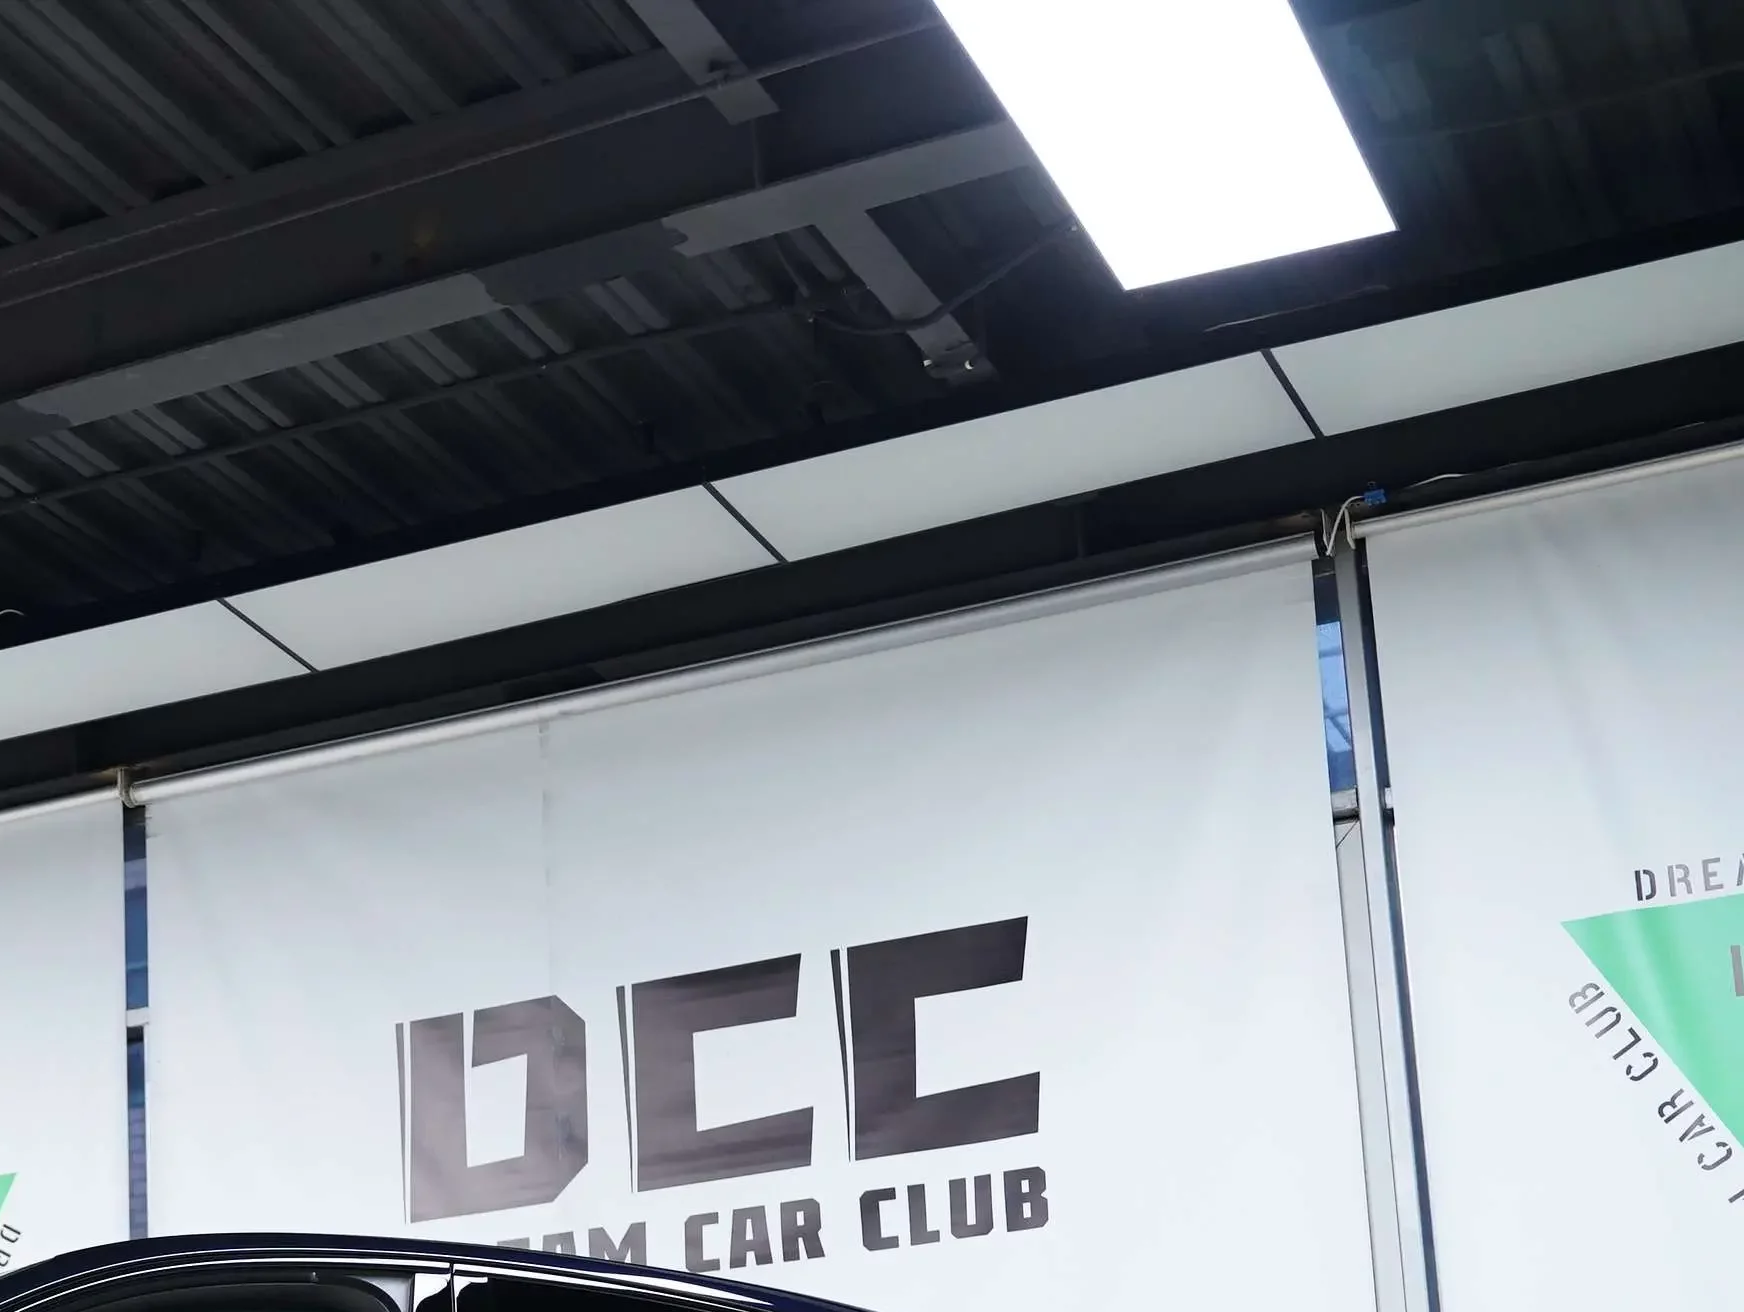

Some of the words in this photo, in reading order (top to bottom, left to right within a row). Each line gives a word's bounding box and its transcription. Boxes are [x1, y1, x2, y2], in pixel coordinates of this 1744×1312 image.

[1633, 853, 1744, 902] DRE
[395, 916, 1041, 1225] DCC
[1568, 982, 1659, 1083] CLUB
[1657, 1088, 1733, 1171] CAR
[683, 1197, 827, 1274] CAR
[859, 1166, 1050, 1252] CLUB
